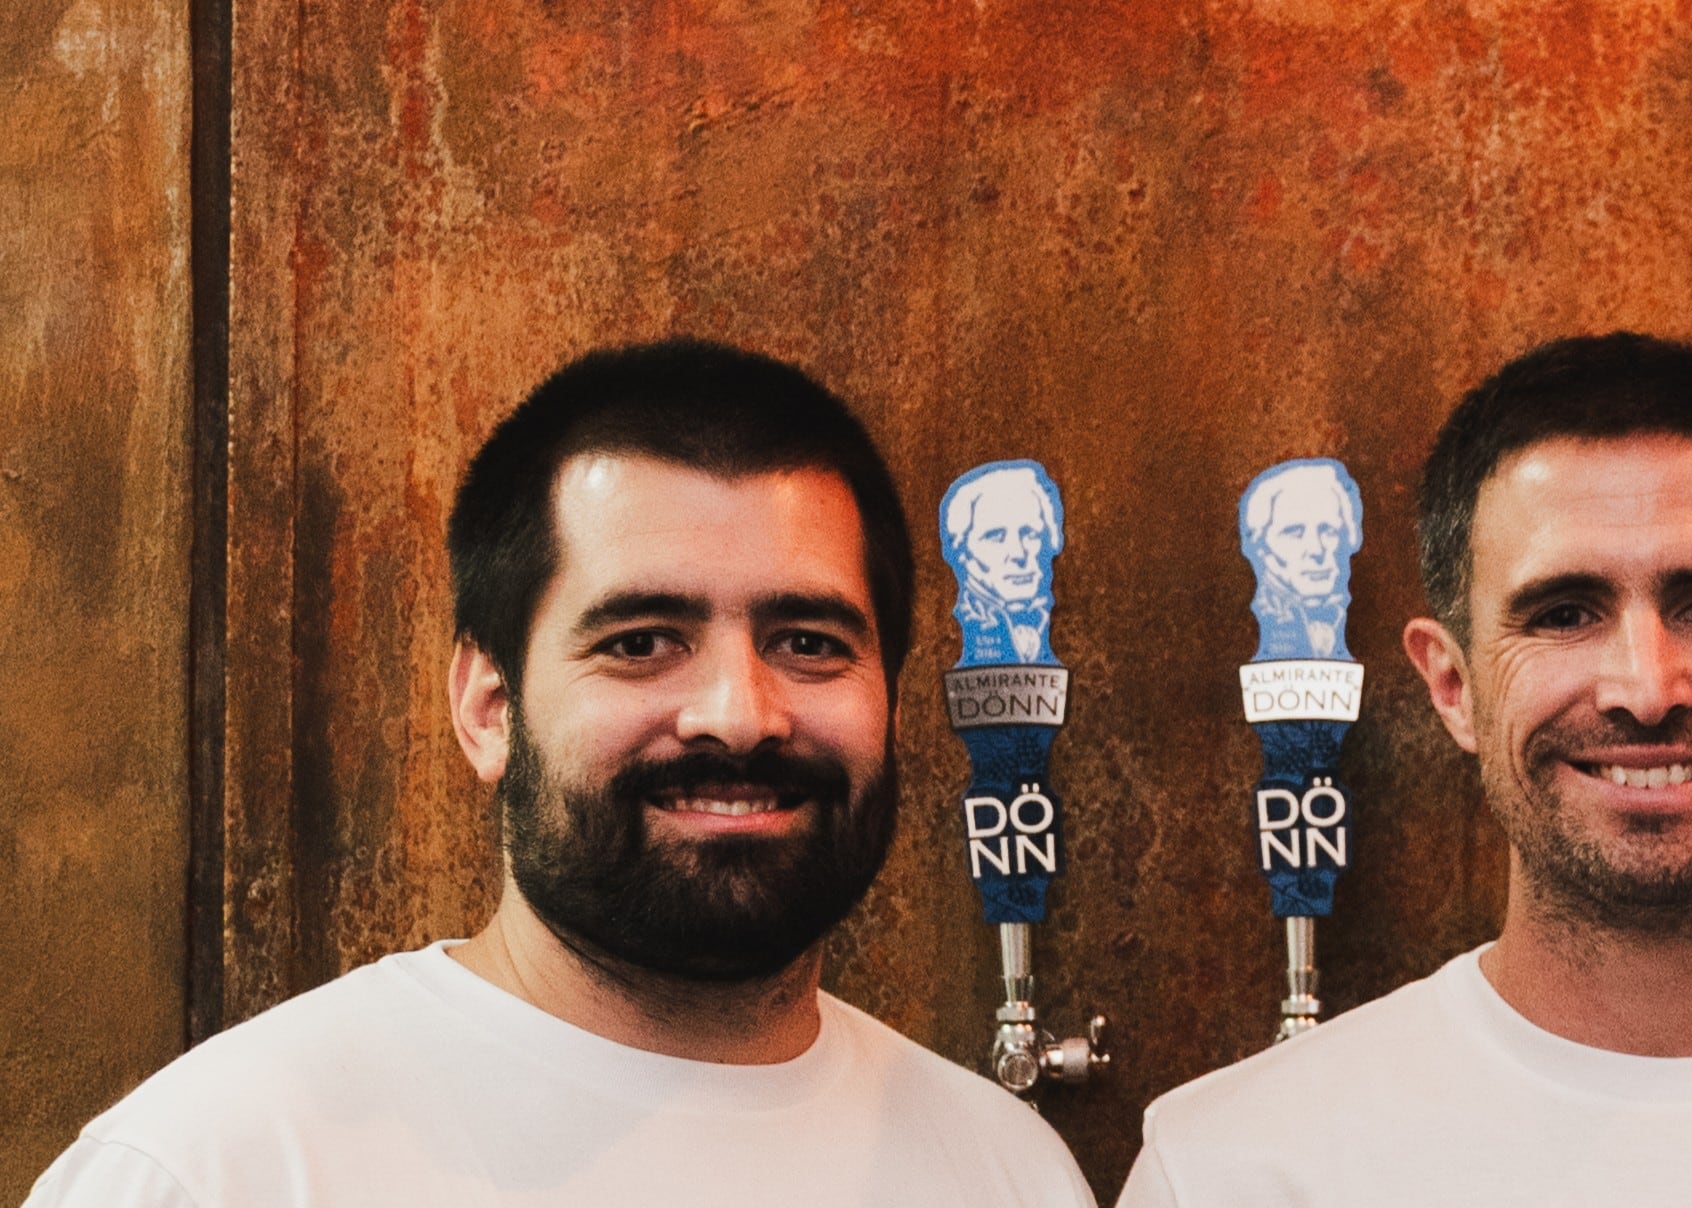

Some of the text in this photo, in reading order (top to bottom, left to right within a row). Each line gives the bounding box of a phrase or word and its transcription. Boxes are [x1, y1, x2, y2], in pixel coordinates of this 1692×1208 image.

[954, 674, 1060, 691] ALMIRANTE
[1250, 668, 1355, 684] ALMIRANTE
[957, 689, 1059, 719] DÖNN
[1252, 682, 1352, 713] DÖNN
[964, 783, 1054, 838] DÖ
[1257, 776, 1346, 832] DÖ
[969, 832, 1057, 879] NN
[1259, 826, 1347, 871] NN
